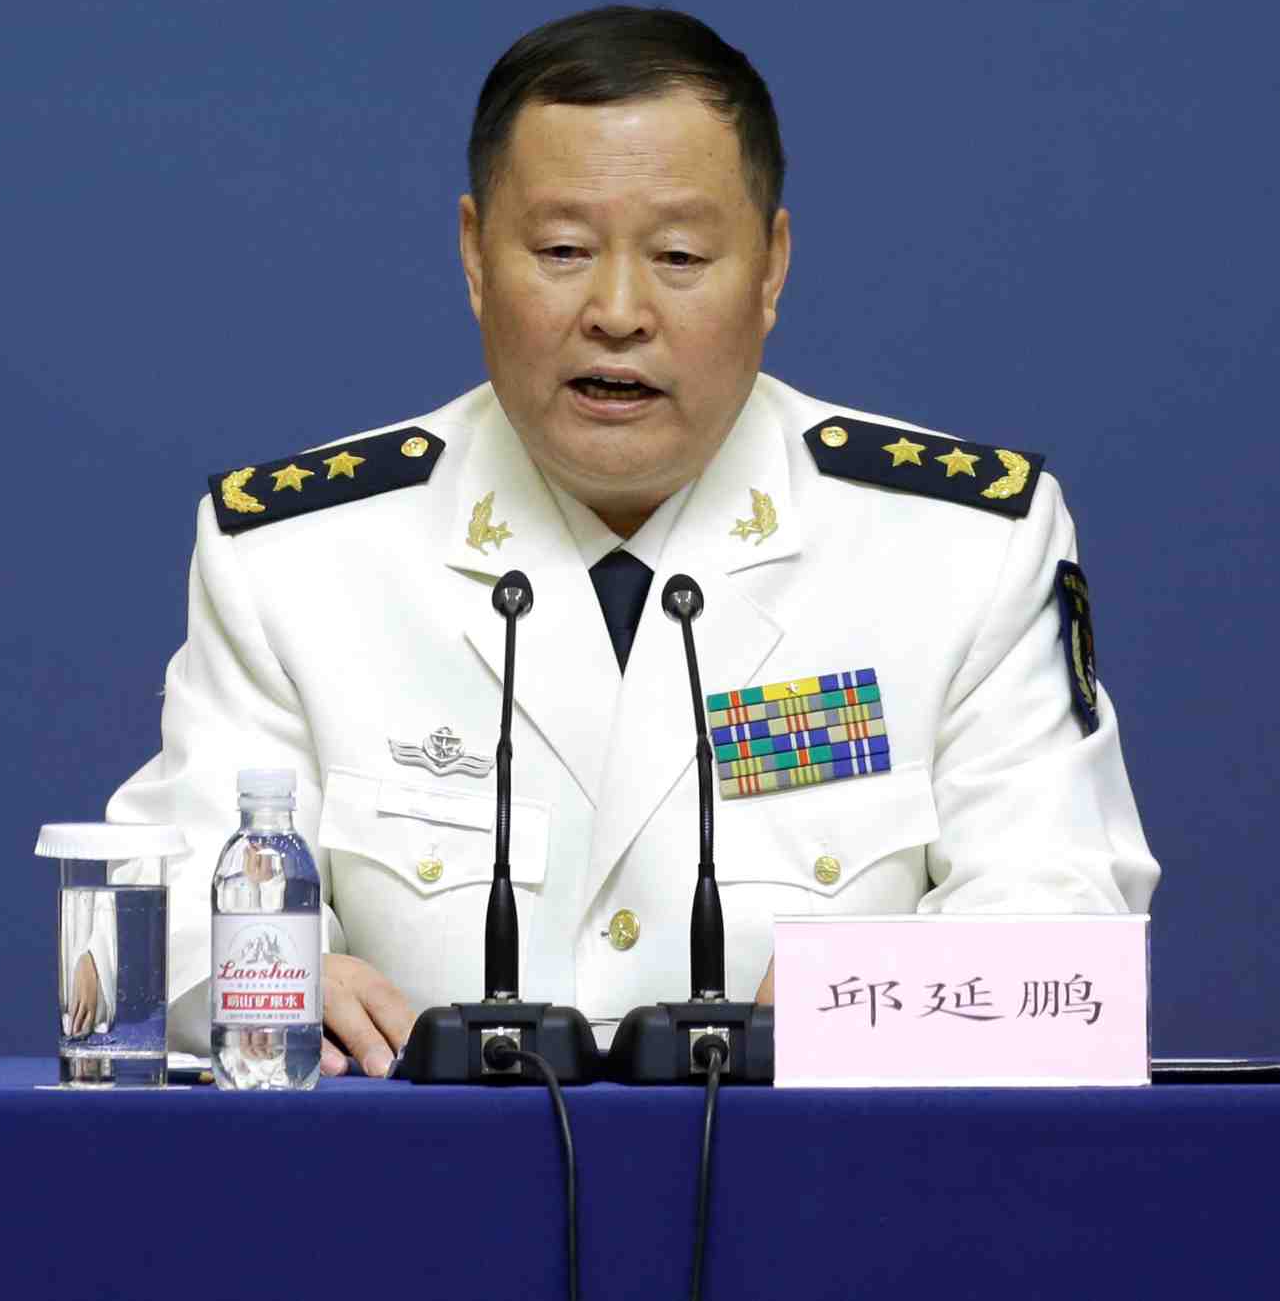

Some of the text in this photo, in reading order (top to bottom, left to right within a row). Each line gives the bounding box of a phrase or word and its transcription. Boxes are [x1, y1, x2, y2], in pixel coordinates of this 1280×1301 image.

[218, 961, 310, 980] Laoshan
[817, 973, 1103, 1028] 邱延鹏
